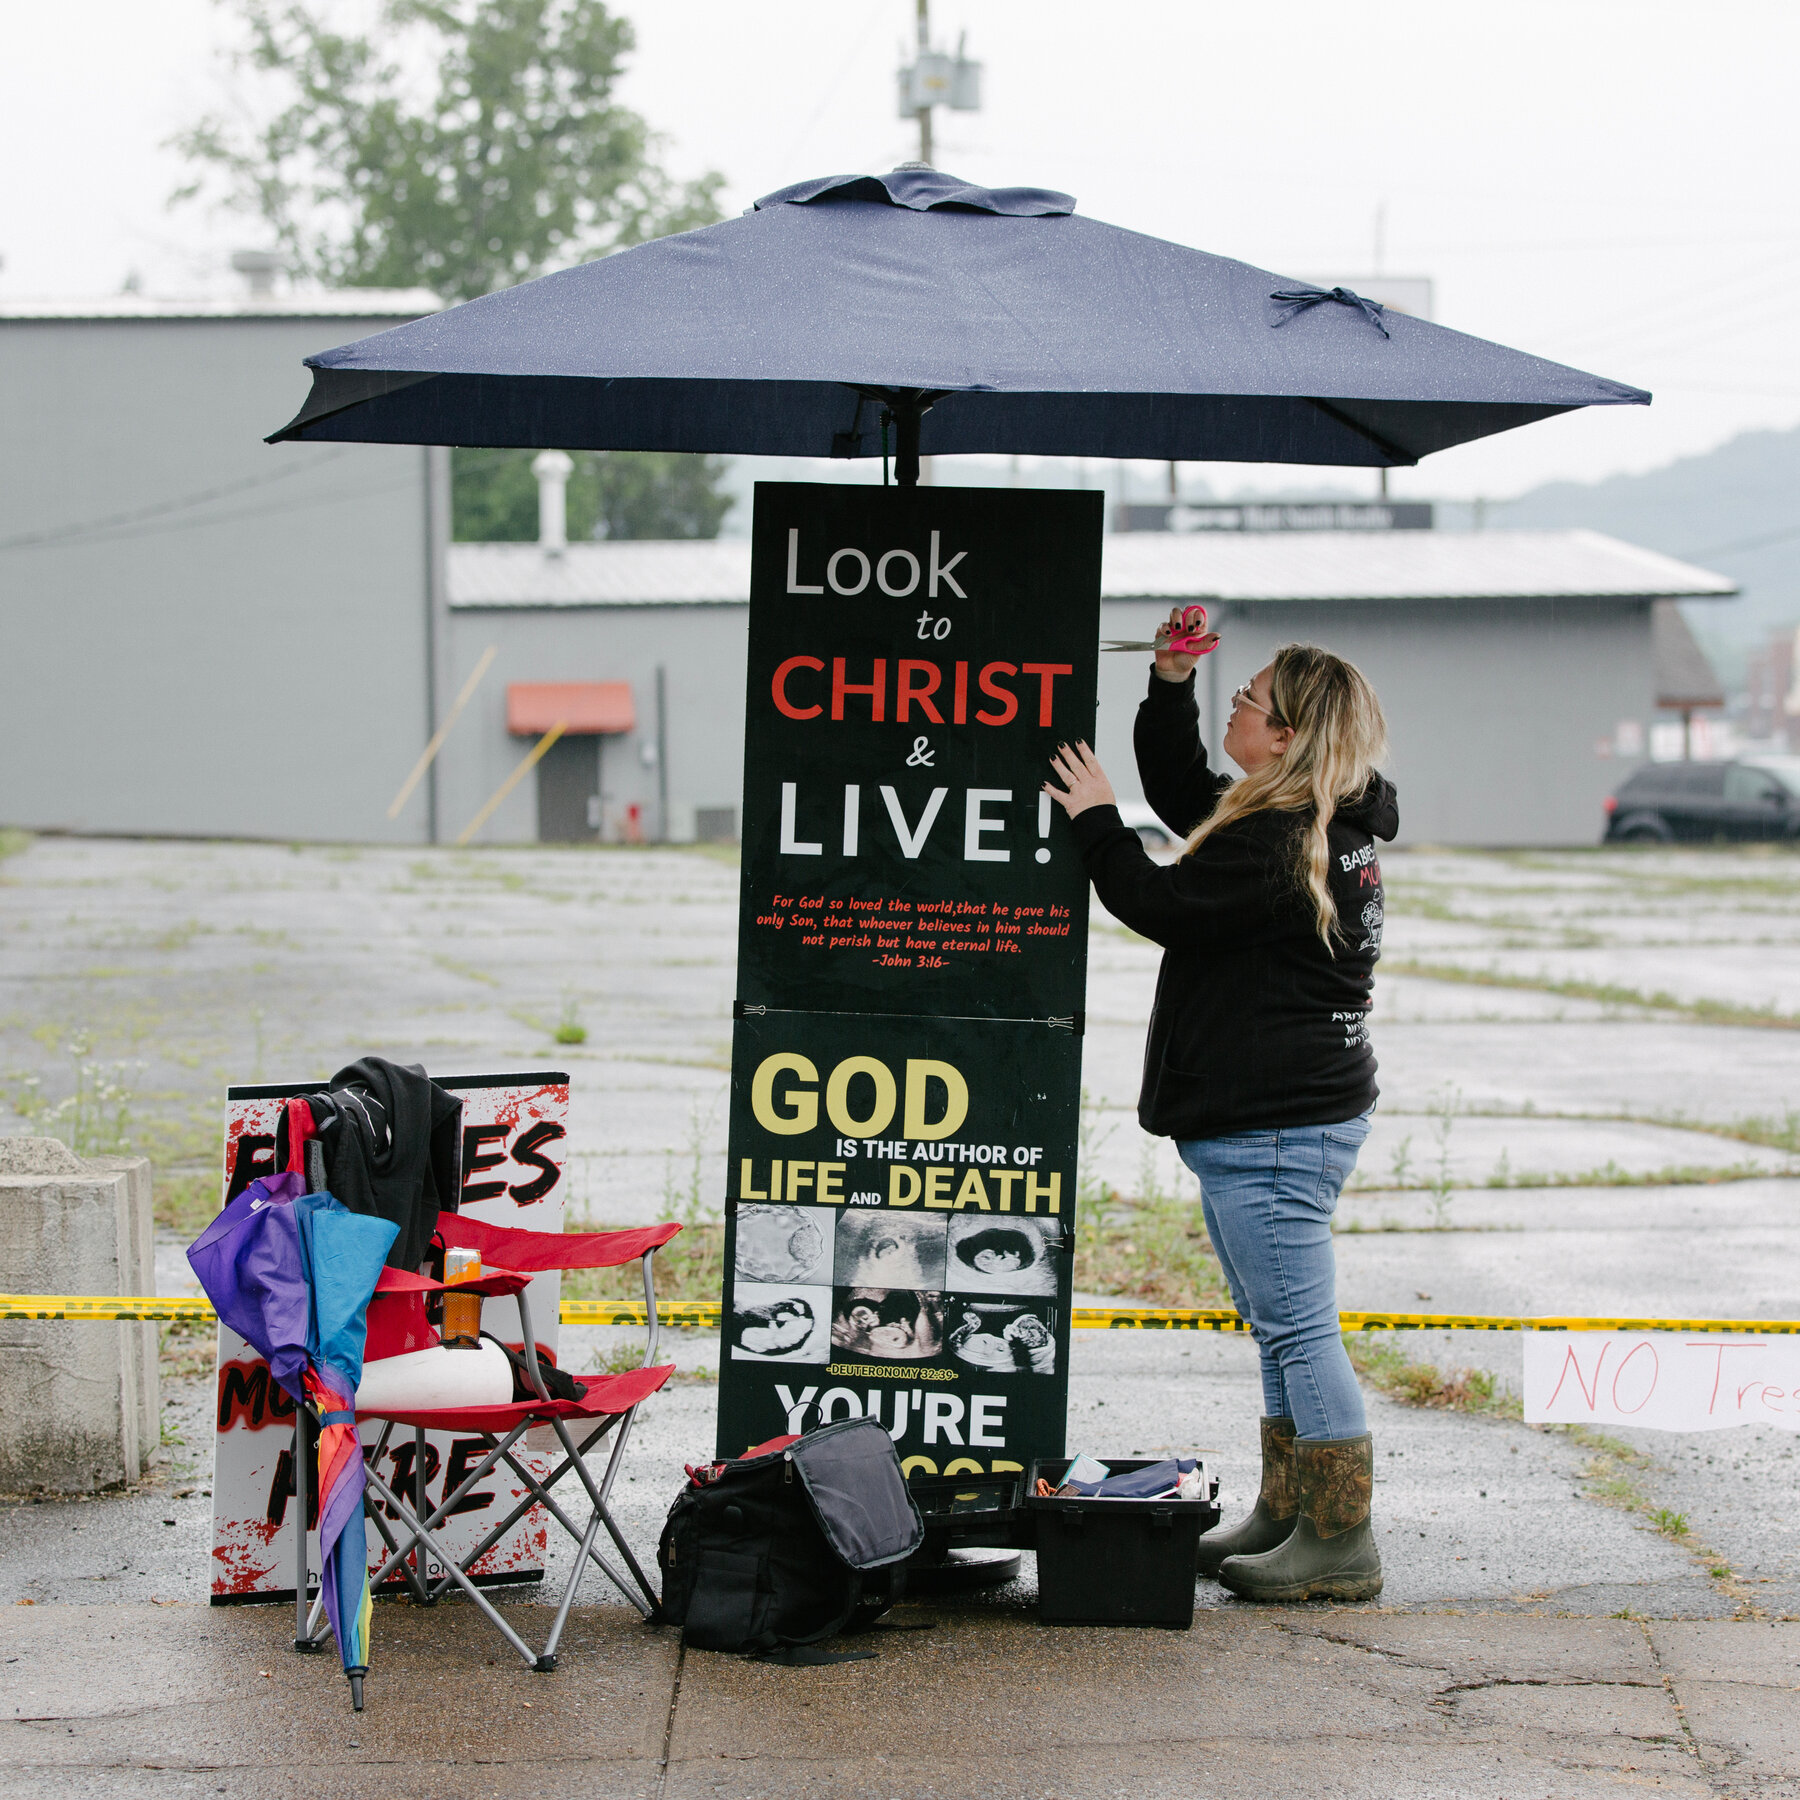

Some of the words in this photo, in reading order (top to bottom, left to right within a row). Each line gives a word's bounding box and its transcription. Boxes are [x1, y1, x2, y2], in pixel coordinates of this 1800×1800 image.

[787, 528, 968, 598] Look
[916, 610, 952, 640] to
[771, 655, 1073, 728] CHRIST
[906, 735, 935, 767] &
[780, 782, 1052, 865] LIVE!
[772, 895, 794, 908] For
[799, 896, 824, 909] God
[829, 900, 843, 910] so
[849, 897, 883, 911] loved
[888, 898, 911, 912] the
[917, 900, 987, 918] world,that
[992, 902, 1009, 915] he
[1014, 906, 1044, 920] gave
[1050, 904, 1070, 918] his
[756, 912, 784, 929] only
[789, 914, 817, 930] Son,
[823, 915, 853, 928] that
[859, 916, 913, 930] whoever
[917, 917, 971, 933] believes
[977, 920, 990, 933] in
[995, 920, 1021, 935] him
[1026, 922, 1070, 936] should
[802, 934, 824, 945] not
[829, 934, 871, 950] perish
[877, 935, 900, 948] but
[905, 936, 936, 949] have
[942, 938, 990, 952] eternal
[995, 938, 1022, 953] life.
[872, 954, 911, 967] -John
[916, 955, 950, 968] 3:16-
[751, 1052, 969, 1141] GOD
[836, 1138, 857, 1158] IS
[862, 1140, 907, 1160] THE
[912, 1142, 1006, 1165] AUTHOR
[1012, 1146, 1043, 1166] OF
[740, 1158, 847, 1204] LIFE
[849, 1191, 881, 1206] AND
[888, 1164, 1062, 1214] DEATH
[826, 1364, 920, 1379] -DEUTERONOMY
[920, 1368, 959, 1381] 32:39-
[1546, 1341, 1659, 1414] NO
[774, 1384, 1008, 1448] YOU'RE
